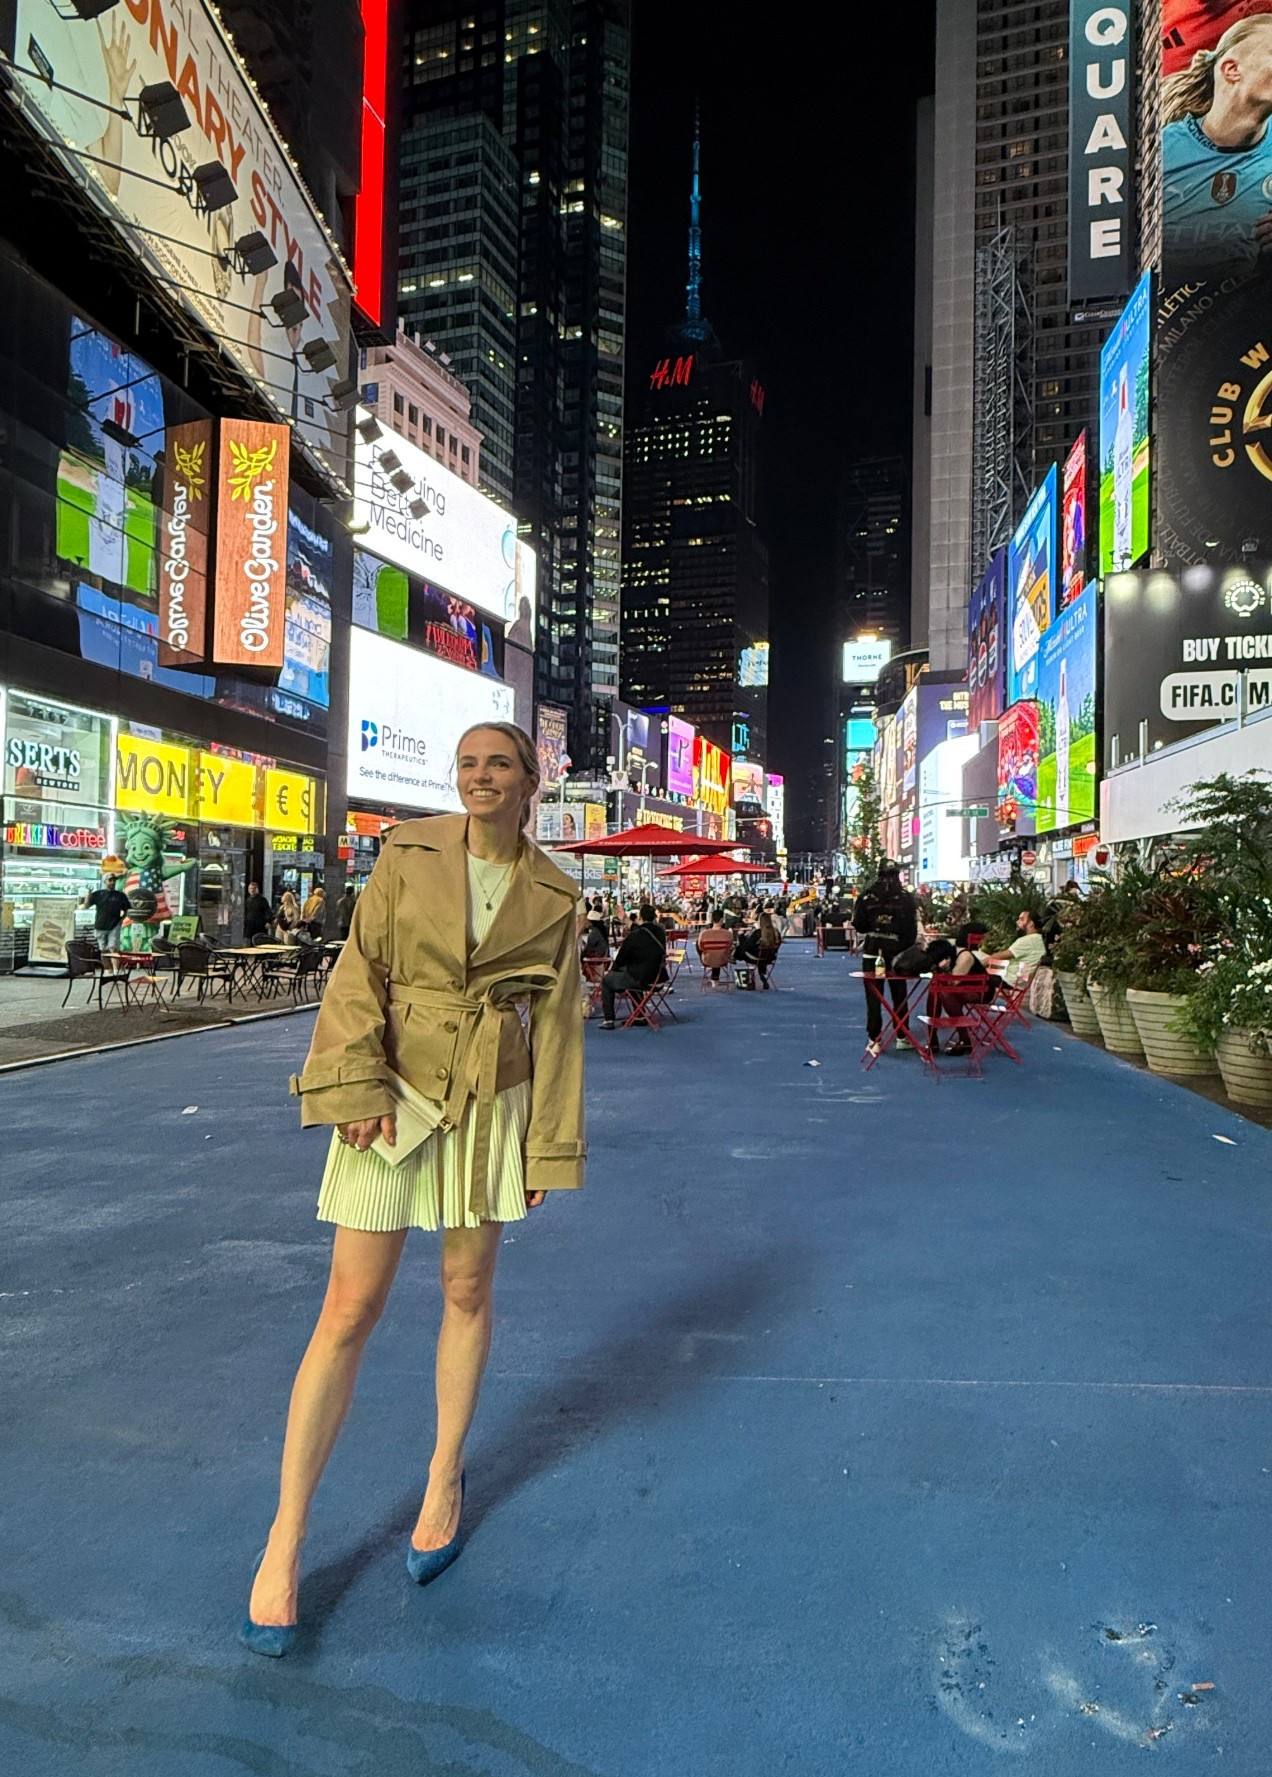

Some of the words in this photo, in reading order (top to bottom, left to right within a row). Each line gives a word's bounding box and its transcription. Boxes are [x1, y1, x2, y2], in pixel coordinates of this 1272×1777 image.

[1084, 7, 1128, 259] QUARE
[1208, 382, 1242, 468] CLUB
[243, 481, 277, 581] Garden
[370, 501, 444, 562] Medicine
[240, 583, 269, 652] Olive
[1066, 602, 1088, 636] ULTRA
[1183, 638, 1220, 662] BUY
[1172, 682, 1269, 708] FIFA.CM
[5, 738, 80, 777] SERTS
[382, 725, 426, 755] Prime
[359, 766, 374, 778] See
[375, 769, 387, 780] the
[388, 772, 421, 787] difference
[7, 823, 59, 846] BREAKFAST
[60, 829, 106, 847] coffee
